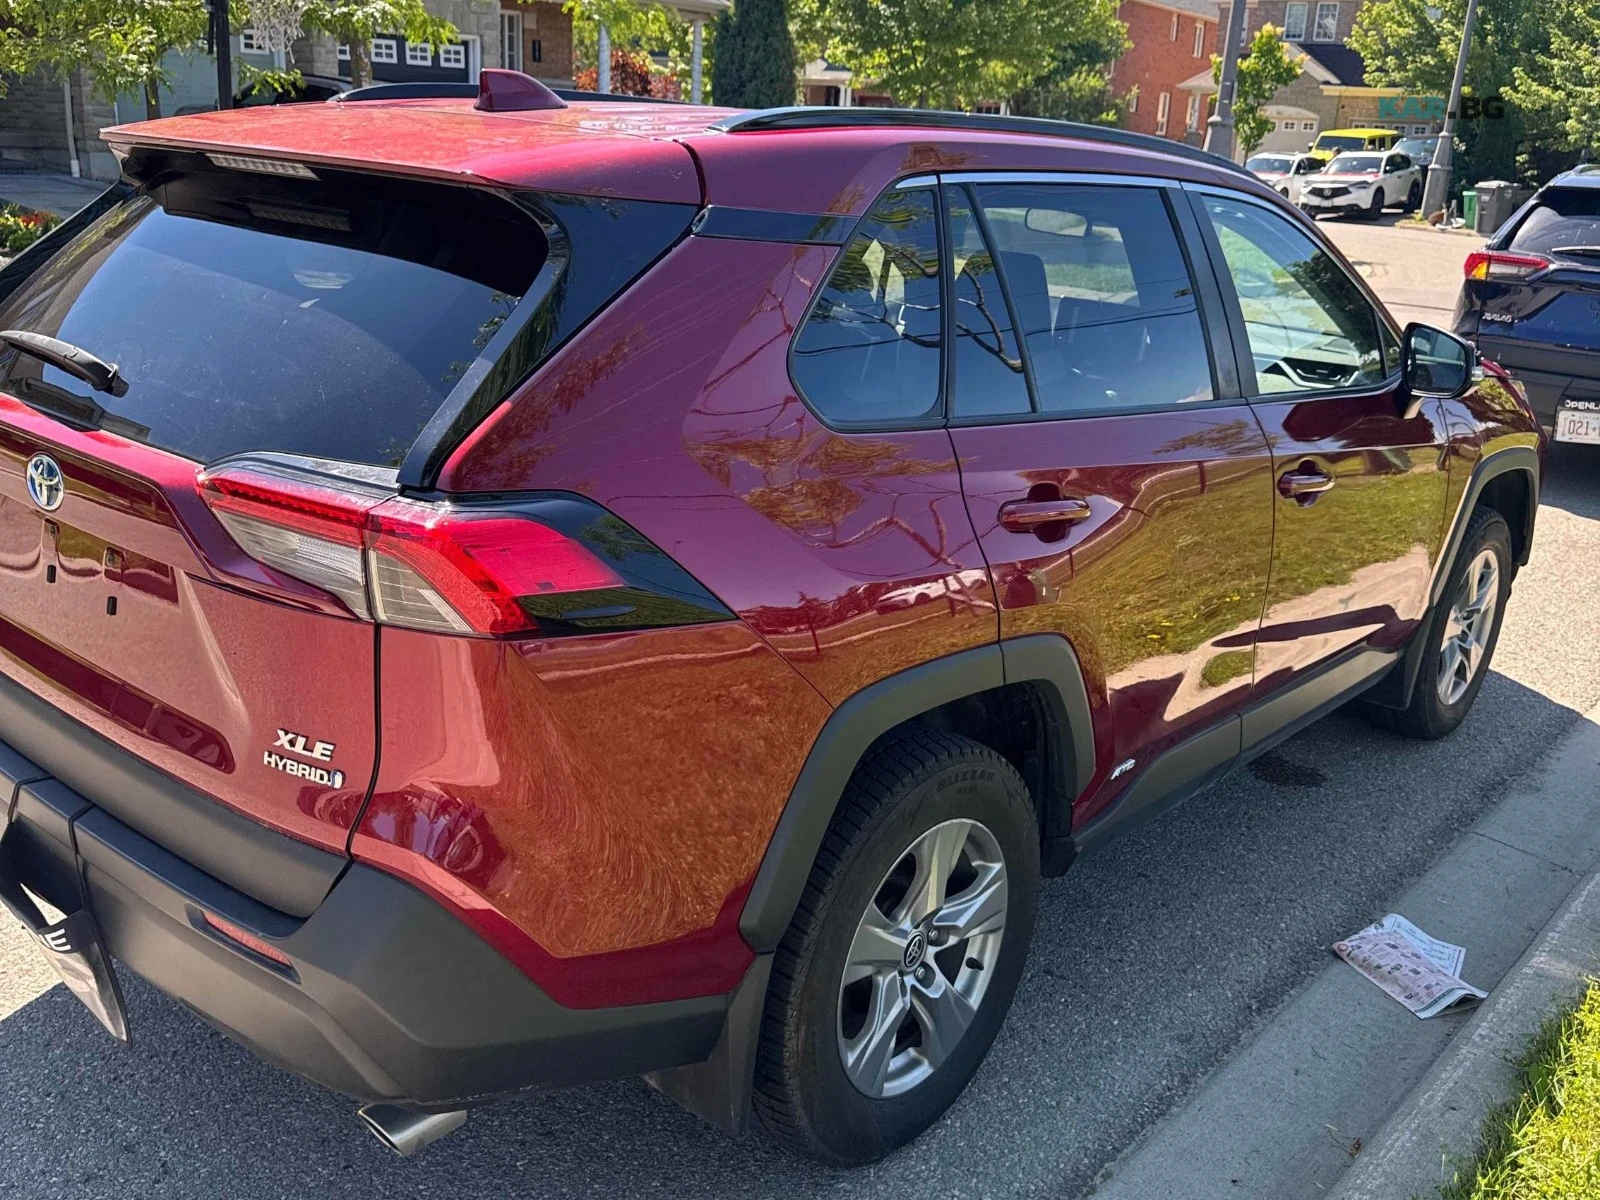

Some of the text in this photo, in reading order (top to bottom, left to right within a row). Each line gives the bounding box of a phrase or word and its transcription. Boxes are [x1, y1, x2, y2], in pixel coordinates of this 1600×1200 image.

[1565, 400, 1600, 410] OPENL
[273, 729, 335, 761] XLE
[263, 751, 329, 785] HYBRID
[937, 769, 996, 792] BLIZZAK
